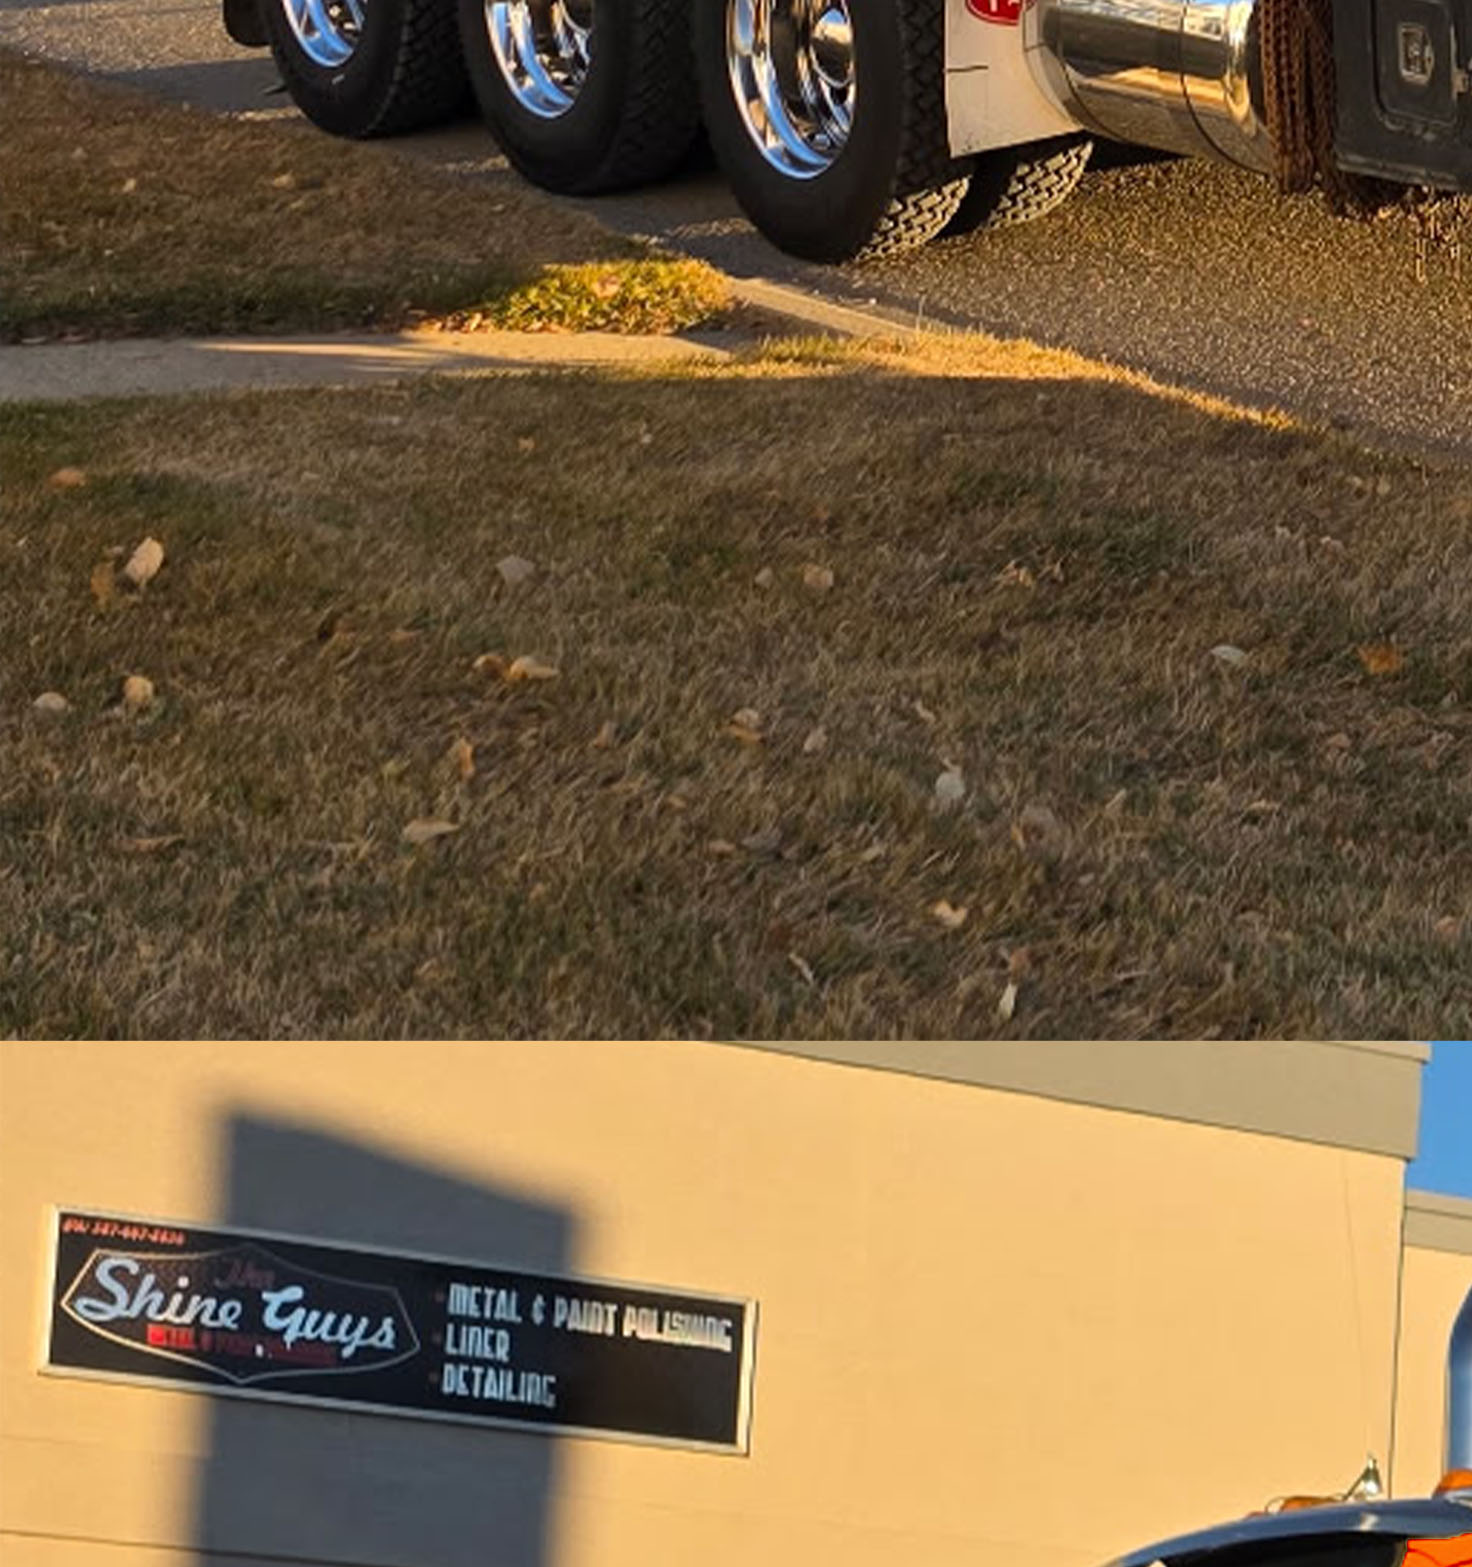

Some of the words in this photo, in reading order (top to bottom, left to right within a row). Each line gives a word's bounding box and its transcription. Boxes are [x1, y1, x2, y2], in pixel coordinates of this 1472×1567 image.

[74, 1256, 242, 1330] Shine
[261, 1285, 396, 1359] Guys
[447, 1282, 522, 1323] METAL
[553, 1294, 619, 1336] PAINT
[622, 1304, 733, 1353] POLISHING
[445, 1323, 510, 1363] LINER
[442, 1363, 557, 1408] DETAILING
